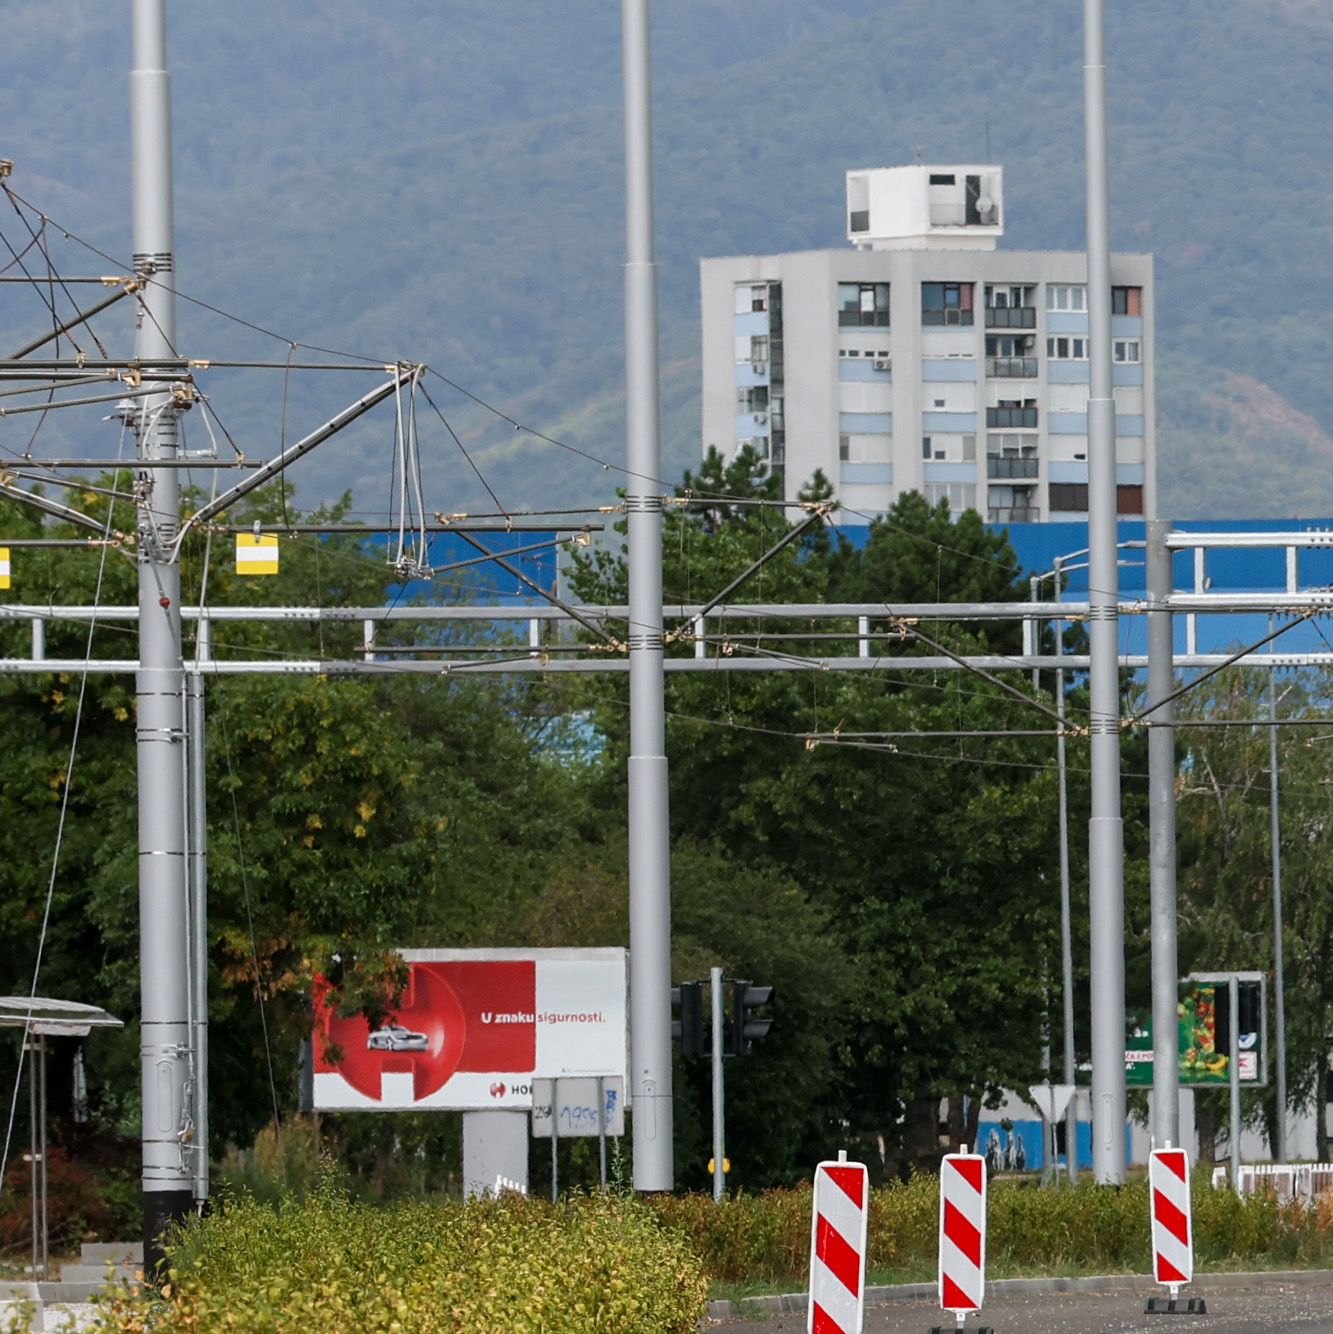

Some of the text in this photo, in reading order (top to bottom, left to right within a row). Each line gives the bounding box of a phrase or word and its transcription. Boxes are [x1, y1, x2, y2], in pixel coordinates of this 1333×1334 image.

[481, 1011, 606, 1024] U znaku sigurnosti.
